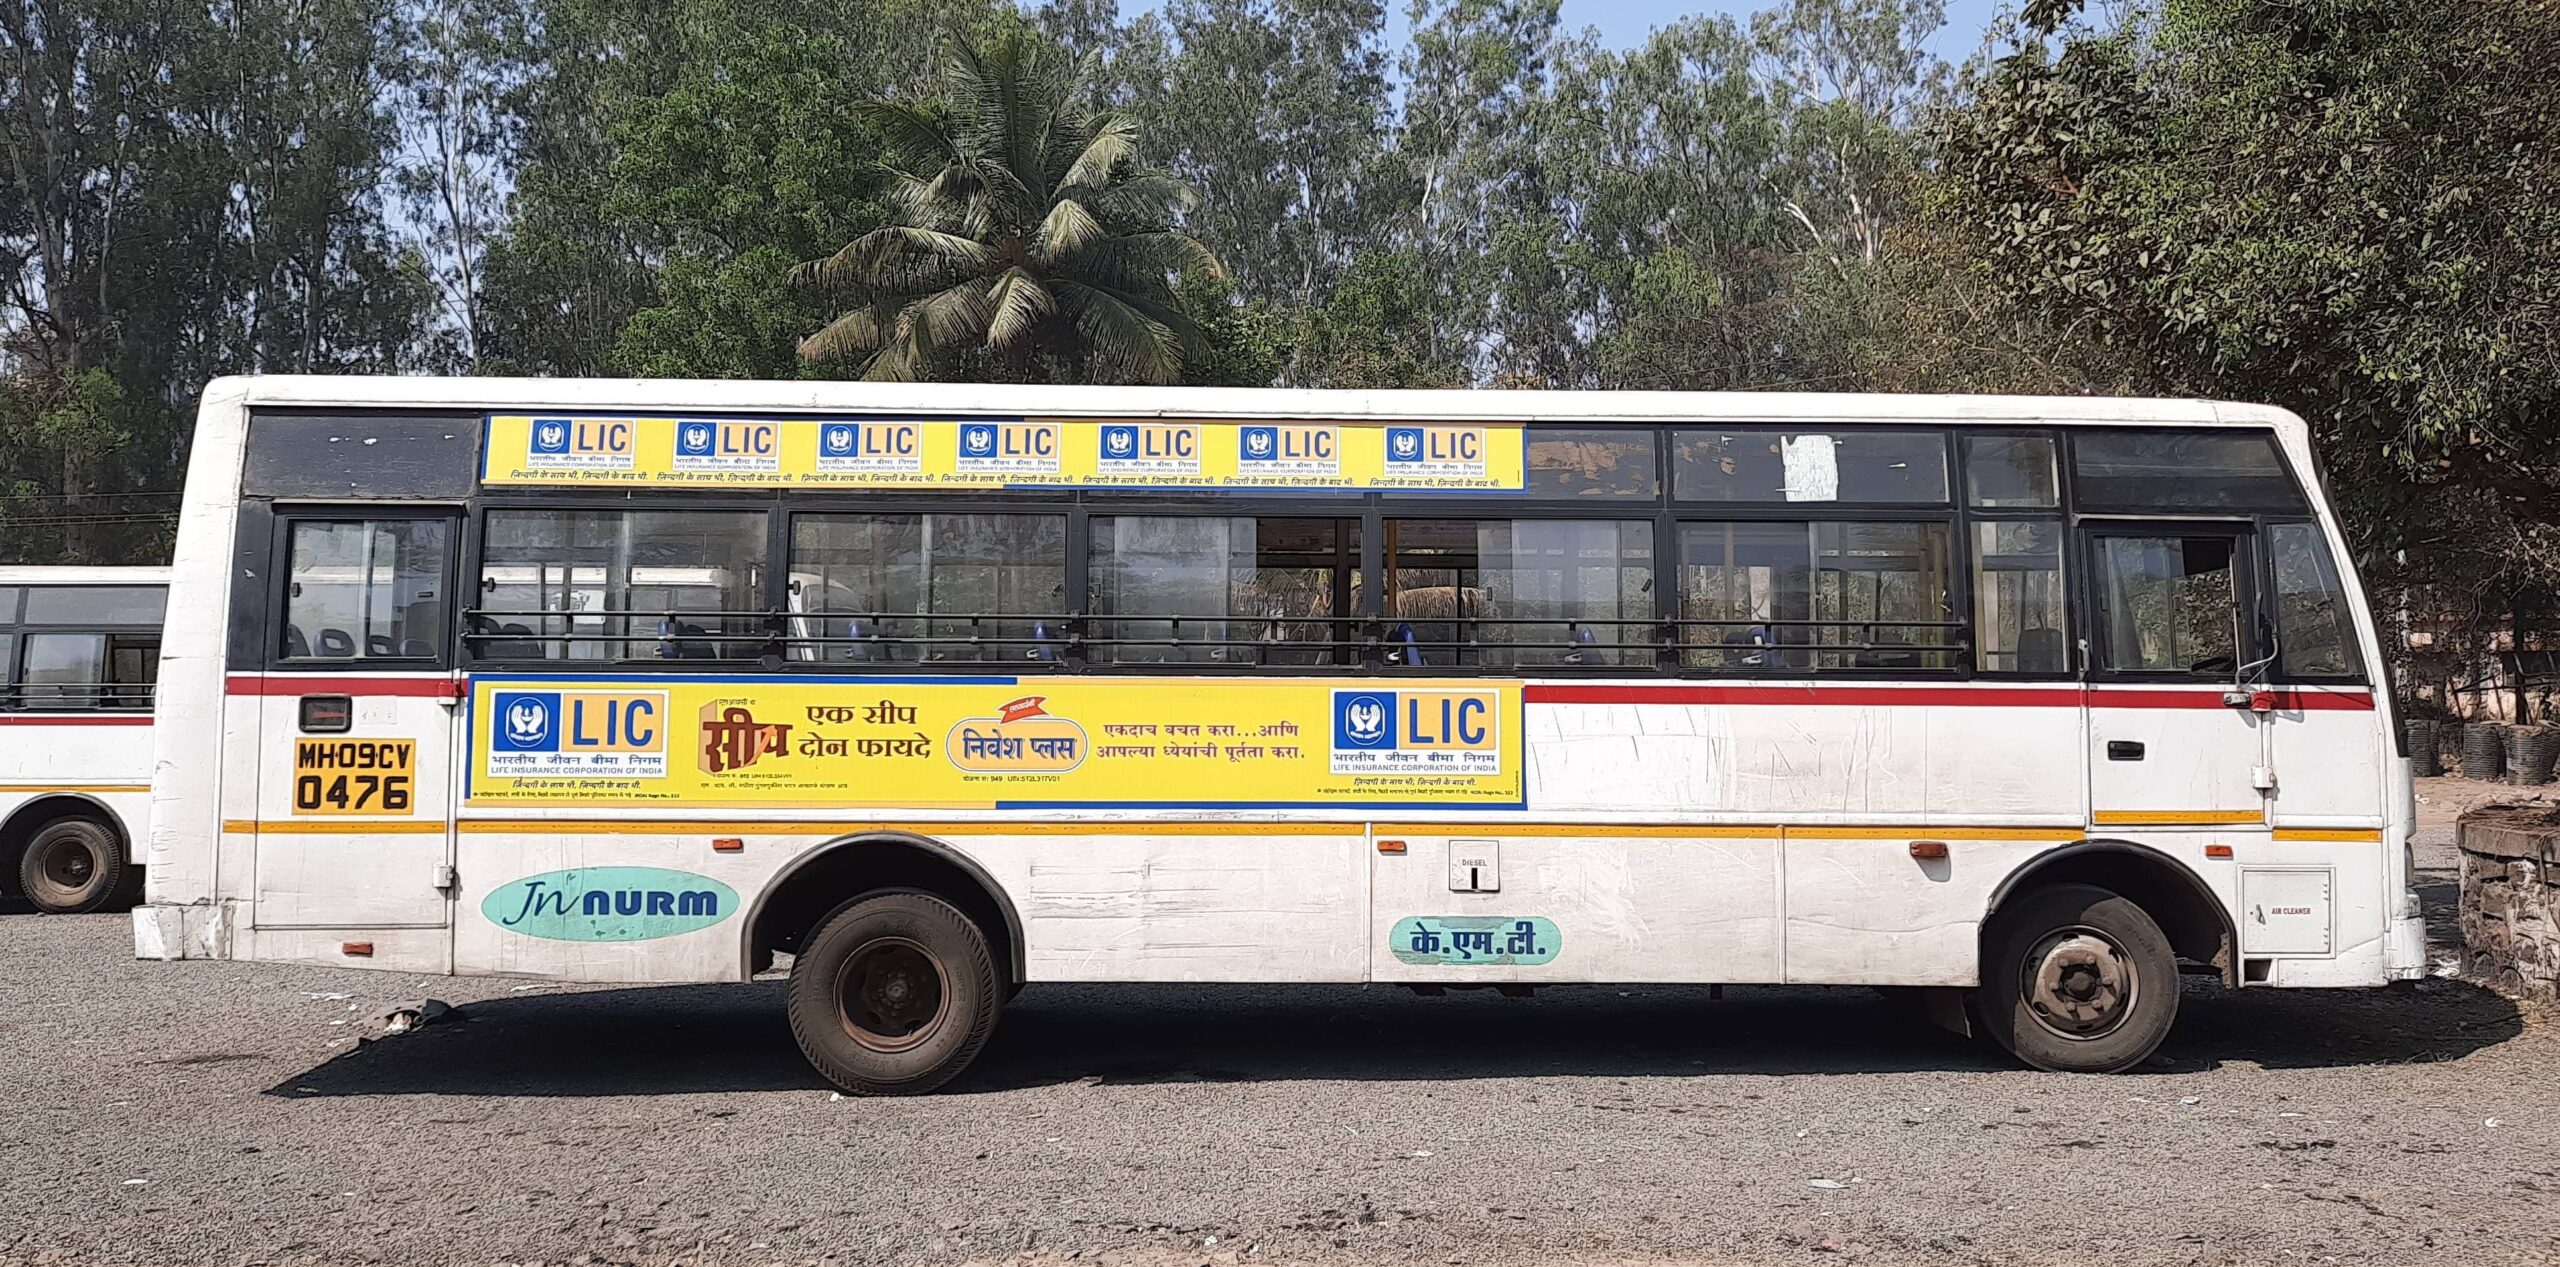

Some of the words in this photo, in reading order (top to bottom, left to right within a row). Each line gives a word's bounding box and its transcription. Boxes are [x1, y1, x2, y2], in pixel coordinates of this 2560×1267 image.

[578, 424, 626, 451] LIC
[723, 426, 772, 454] LIC
[866, 427, 913, 454] LIC
[1005, 428, 1052, 455] LIC
[1146, 430, 1192, 457] LIC
[1285, 431, 1331, 458] LIC
[1431, 432, 1477, 459] LIC
[573, 699, 653, 747] LIC
[806, 706, 855, 725] एक
[862, 700, 918, 724] सीप
[1409, 698, 1486, 744] LIC
[798, 732, 849, 758] दोन
[856, 732, 932, 758] फायदे
[963, 728, 1025, 760] निवेश
[1030, 738, 1078, 760] प्लस
[1104, 725, 1157, 738] एकदाच
[492, 754, 536, 765] भारतीय
[546, 754, 581, 765] जीवन
[591, 754, 619, 765] बीमा
[629, 754, 662, 765] निगम
[1097, 745, 1156, 758] आपल्या
[1163, 741, 1218, 758] ध्येयांची
[1225, 742, 1264, 763] पूर्तता
[1271, 746, 1305, 759] करा.
[1334, 752, 1376, 763] भारतीय
[1386, 752, 1418, 763] जीवन
[1427, 752, 1454, 763] बीमा
[1463, 752, 1495, 763] निगम
[491, 766, 509, 775] LIFE
[511, 766, 561, 775] INSURANCE
[563, 766, 622, 775] CORPORATION
[626, 766, 636, 775] OF
[639, 766, 663, 775] INDIA
[1333, 764, 1350, 772] LIFE
[1352, 764, 1399, 772] INSURANCE
[1401, 764, 1458, 772] CORPORATION
[1461, 764, 1472, 772] OF
[1474, 764, 1497, 772] INDIA
[297, 775, 409, 810] 0476
[1462, 859, 1488, 867] DIESEL
[2271, 907, 2282, 915] AIR
[2283, 907, 2311, 915] CLEANER
[1410, 921, 1546, 959] के.एम.टी.
